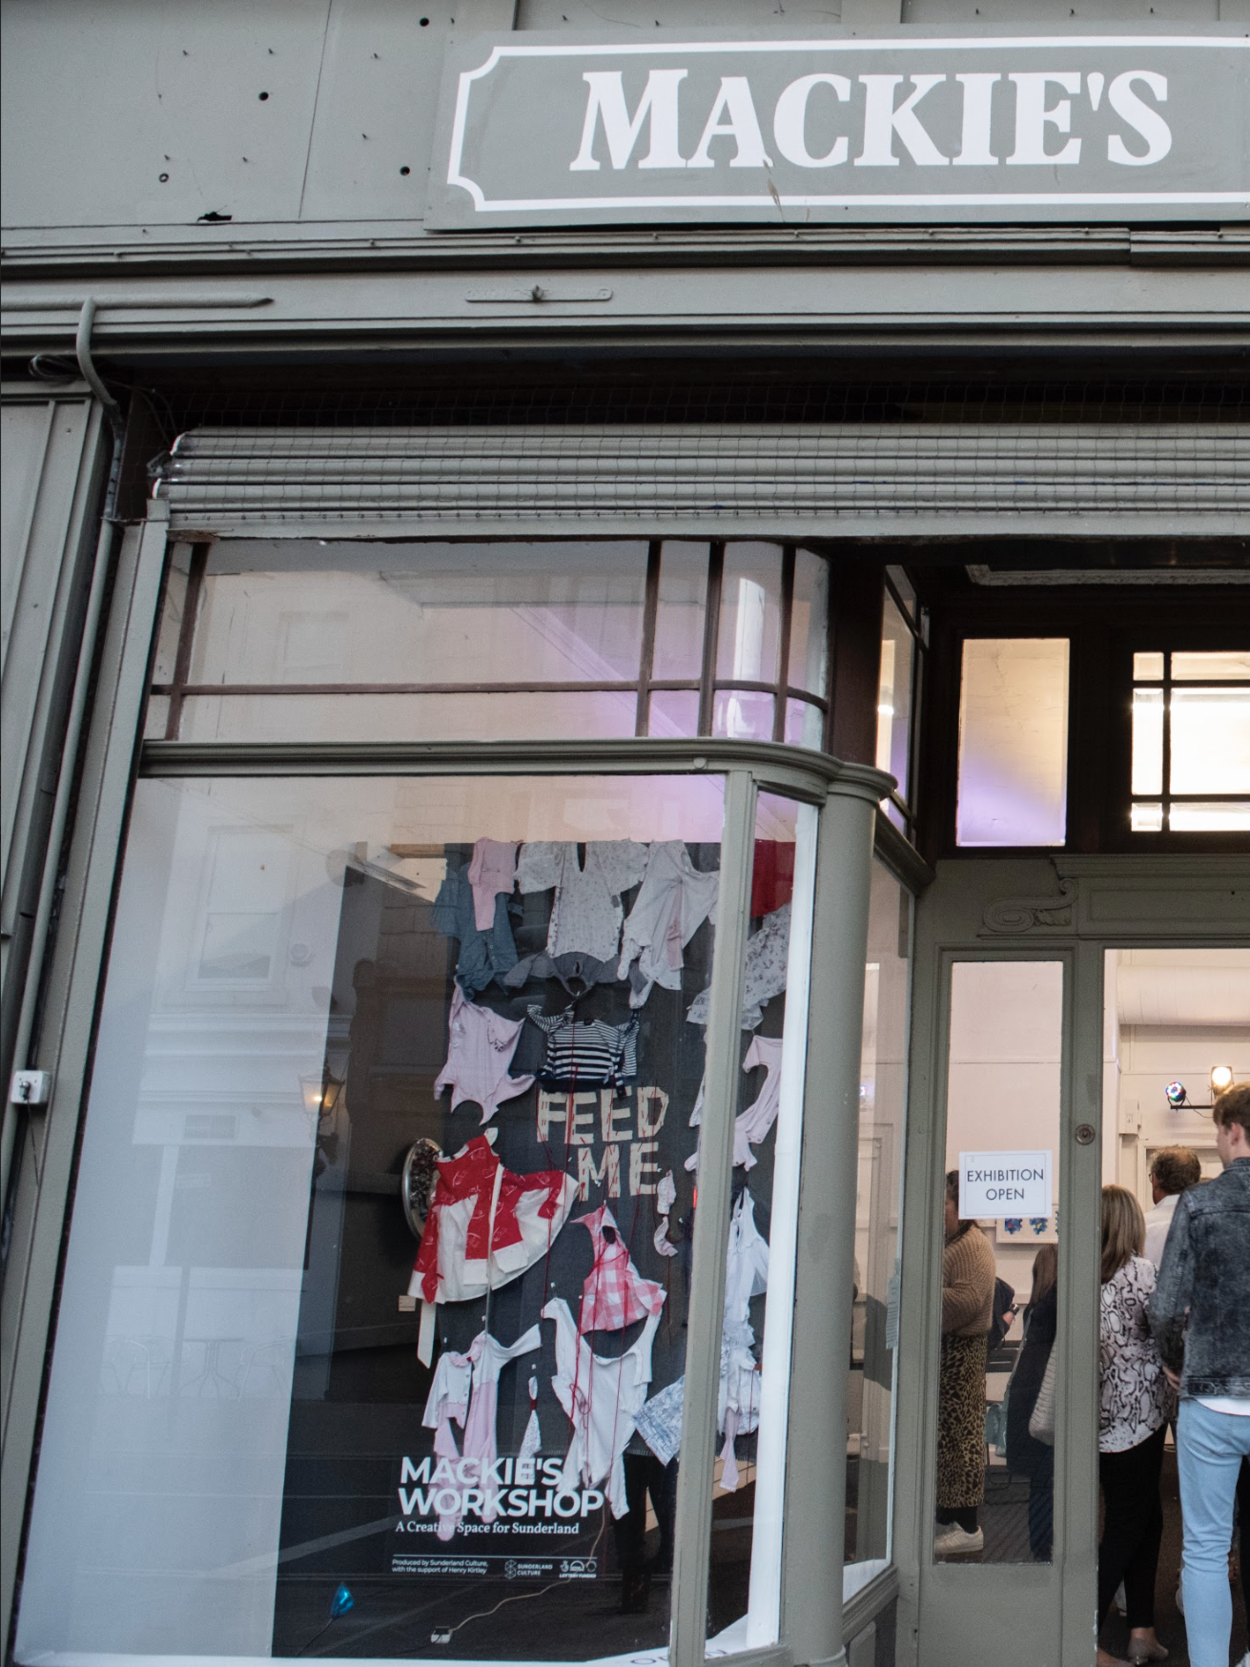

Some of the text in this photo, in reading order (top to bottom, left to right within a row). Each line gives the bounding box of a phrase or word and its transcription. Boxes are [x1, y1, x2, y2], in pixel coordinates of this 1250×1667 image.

[570, 69, 1173, 171] MACKIE'S
[536, 1086, 670, 1145] FEED
[576, 1142, 660, 1202] ME
[967, 1168, 1045, 1182] EXHIBITION
[985, 1188, 1025, 1201] OPEN
[400, 1456, 564, 1486] MACKIE'S
[398, 1487, 605, 1518] WORKSHOP
[395, 1521, 580, 1536] A Creative Space for Sunderland
[391, 1559, 421, 1567] Produced
[421, 1560, 430, 1568] by
[430, 1559, 465, 1567] Sunderland
[418, 1567, 443, 1575] support
[449, 1566, 466, 1575] Henry
